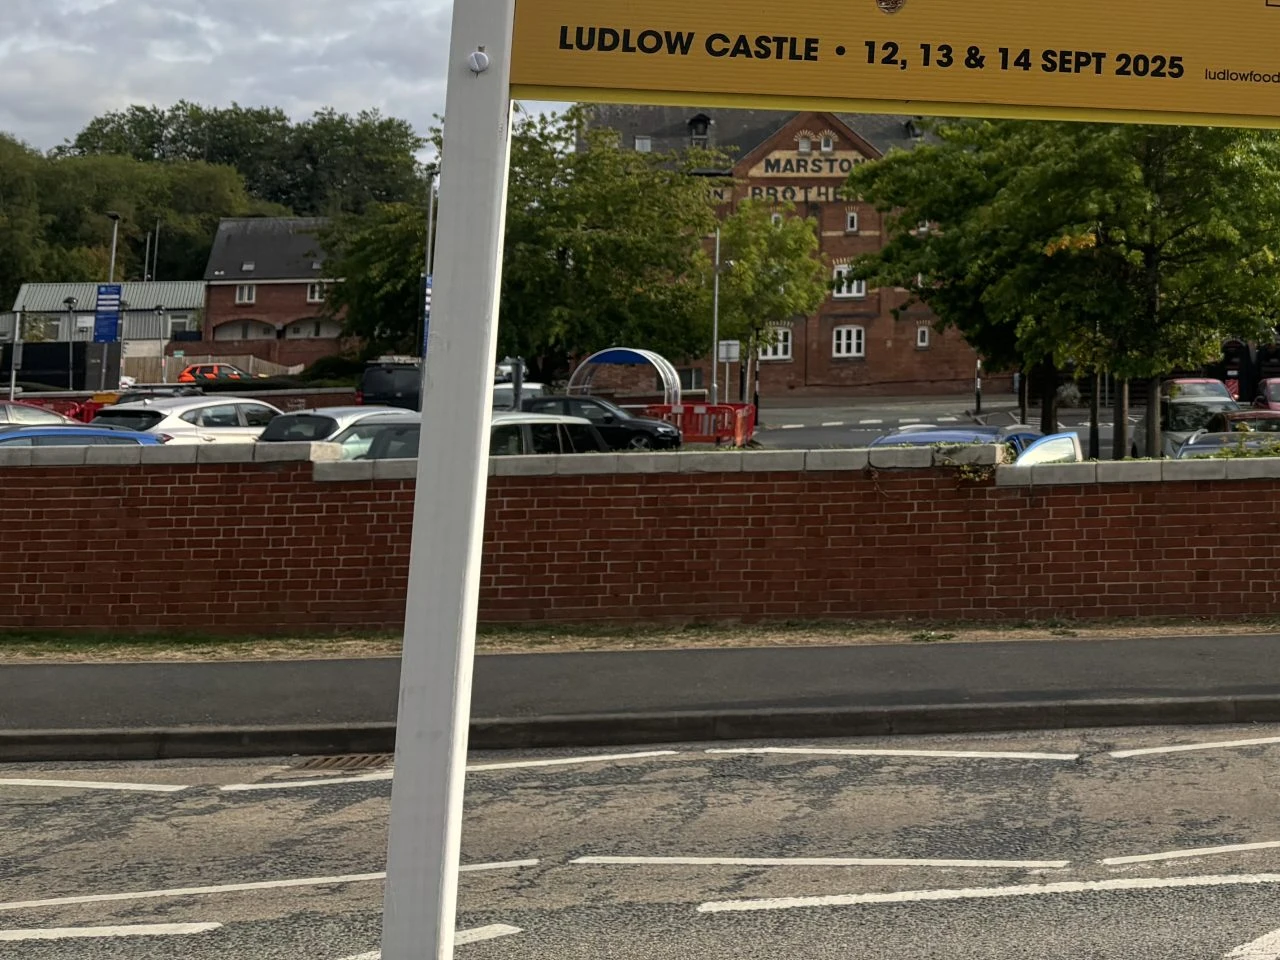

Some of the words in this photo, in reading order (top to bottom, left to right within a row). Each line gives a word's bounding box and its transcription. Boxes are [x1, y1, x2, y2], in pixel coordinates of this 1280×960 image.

[559, 25, 695, 55] LUDLOW
[705, 33, 820, 61] CASTLE
[864, 40, 907, 70] 12,
[920, 43, 954, 68] 13
[964, 45, 986, 69] &
[998, 47, 1032, 71] 14
[1041, 49, 1107, 75] SEPT
[1115, 53, 1185, 79] 2025
